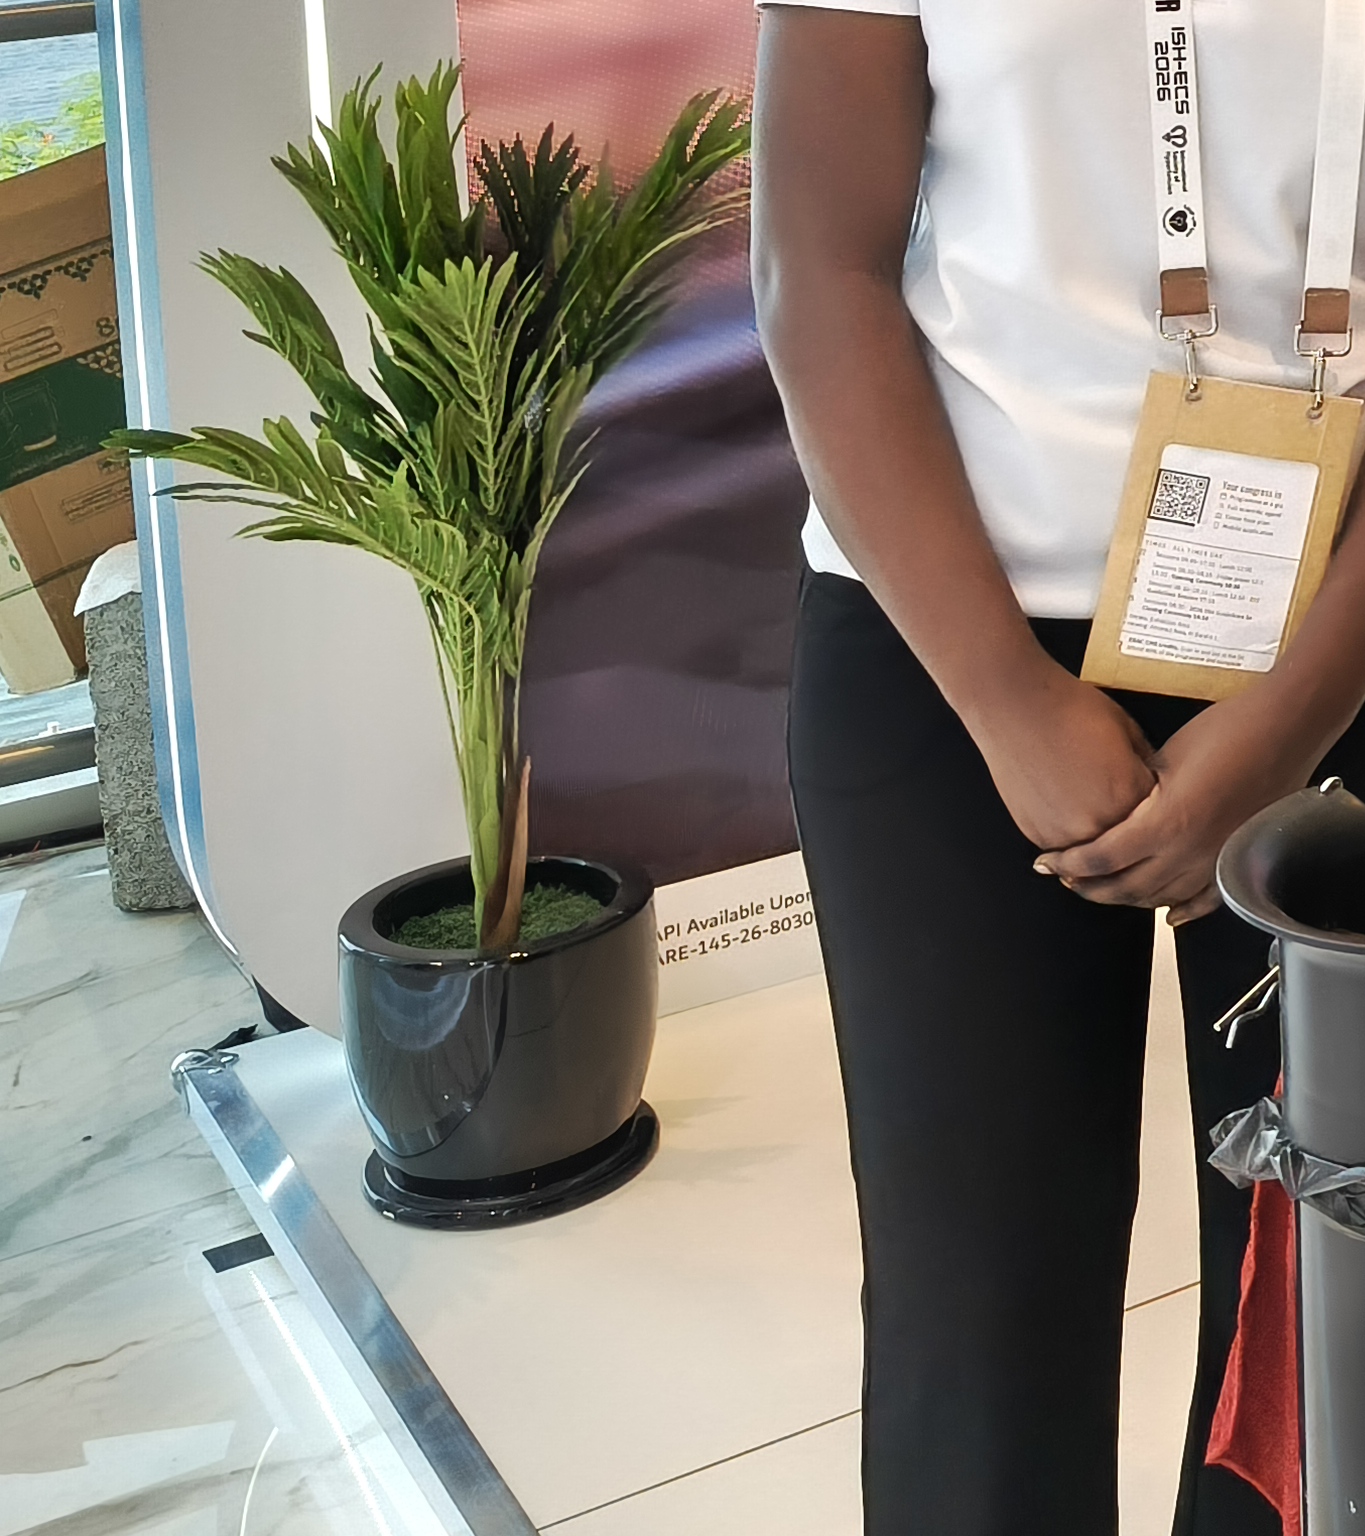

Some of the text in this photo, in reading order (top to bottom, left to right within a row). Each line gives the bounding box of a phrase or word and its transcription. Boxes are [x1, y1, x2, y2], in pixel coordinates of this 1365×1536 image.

[1154, 41, 1171, 102] 2026
[1171, 26, 1190, 115] ISH-ECS
[658, 911, 814, 966] RE-145-26-8030
[687, 901, 765, 934] Available
